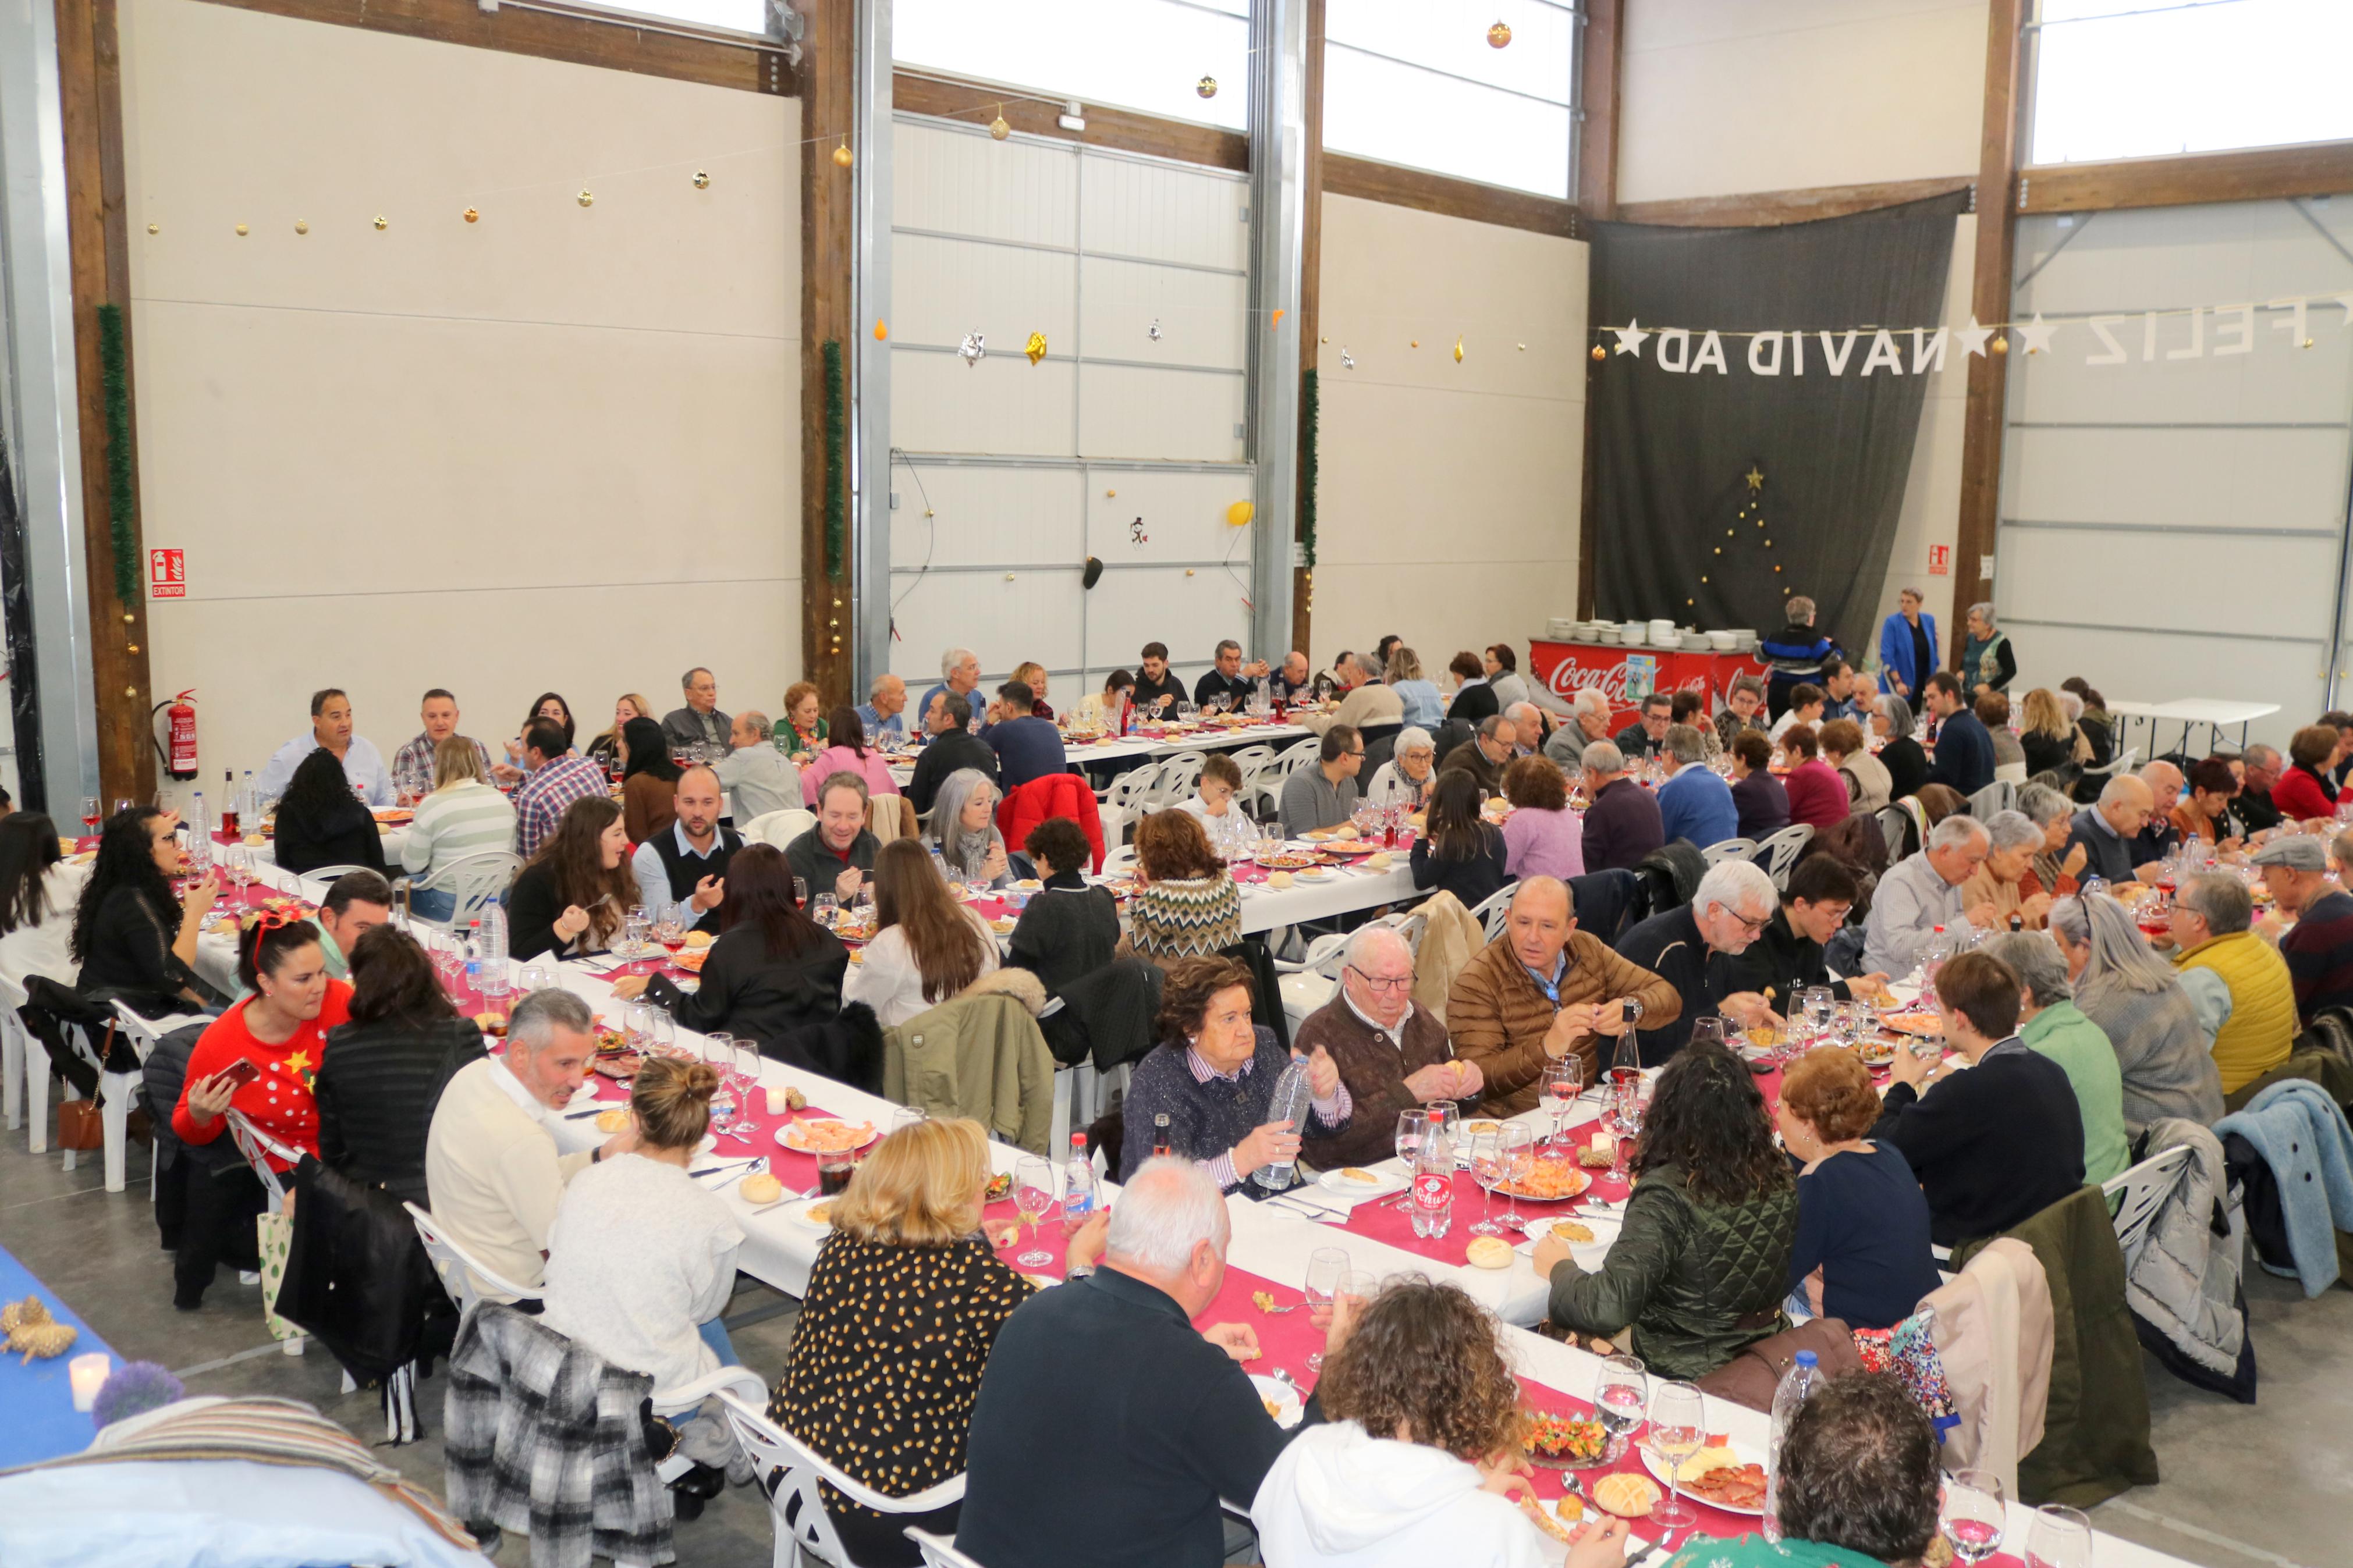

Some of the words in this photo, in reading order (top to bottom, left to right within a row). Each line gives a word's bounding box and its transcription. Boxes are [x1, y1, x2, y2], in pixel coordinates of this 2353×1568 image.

[153, 586, 184, 595] EXTINTOR
[1549, 657, 1662, 703] Coca-Co
[1415, 1187, 1449, 1204] Schuss
